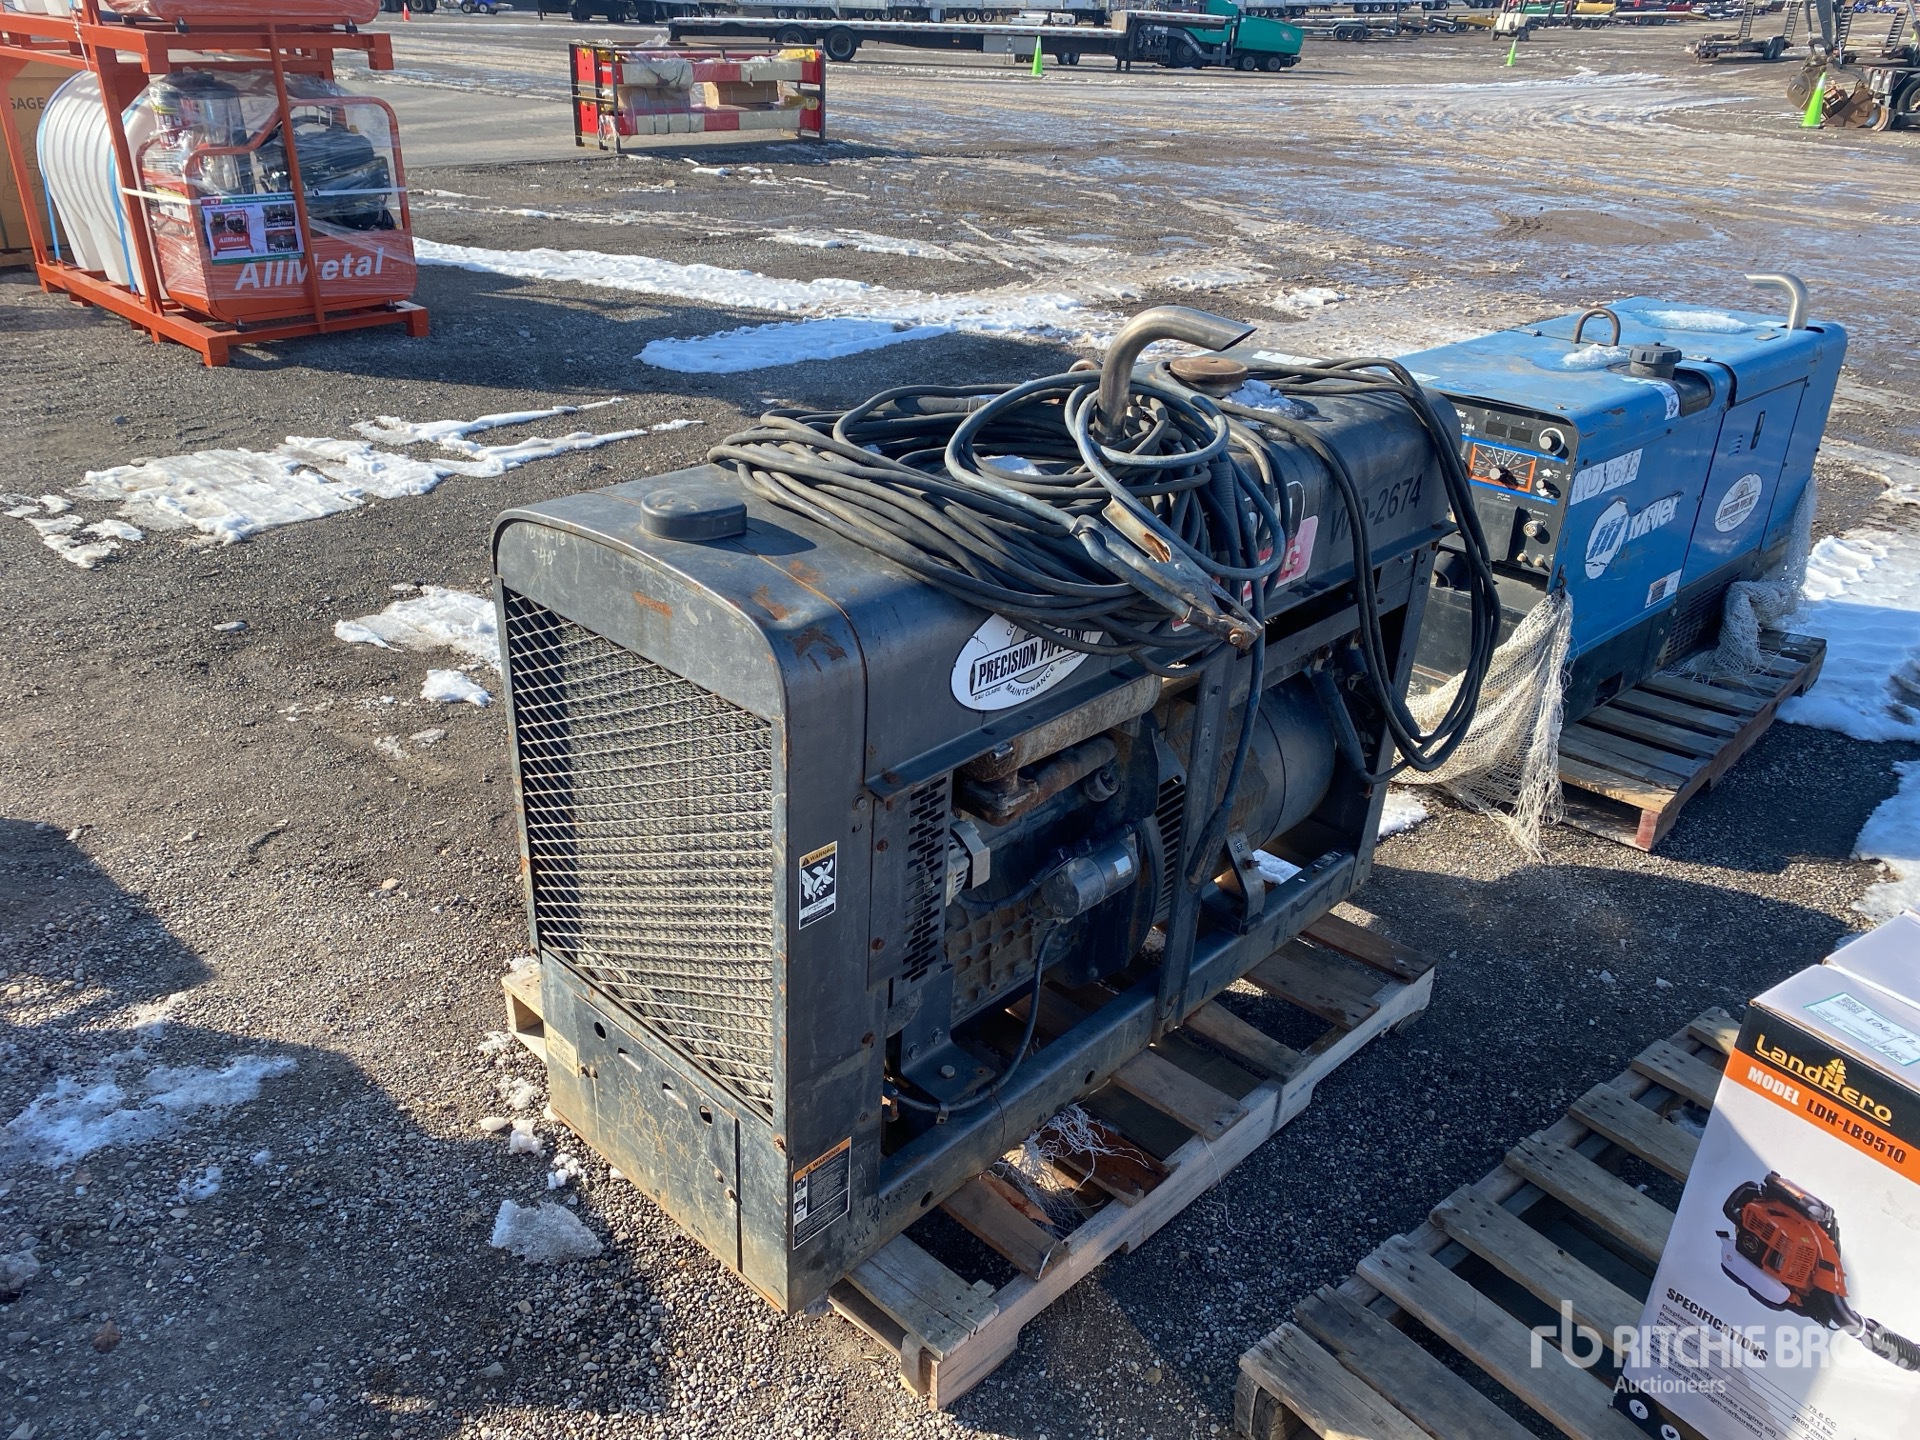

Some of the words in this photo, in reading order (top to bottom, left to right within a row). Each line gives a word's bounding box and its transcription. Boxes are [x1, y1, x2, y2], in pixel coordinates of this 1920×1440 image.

[234, 247, 385, 291] AllMetal
[978, 640, 1038, 687] PRECISION
[1006, 664, 1056, 697] MAINTENANCE
[1755, 1033, 1893, 1124] LandHero
[1747, 1065, 1800, 1107] MODEL
[1805, 1098, 1907, 1165] LDH-LB9510
[812, 1147, 841, 1169] WARNING
[1659, 1311, 1681, 1330] Power
[1666, 1287, 1769, 1362] SPECIFICATIONS
